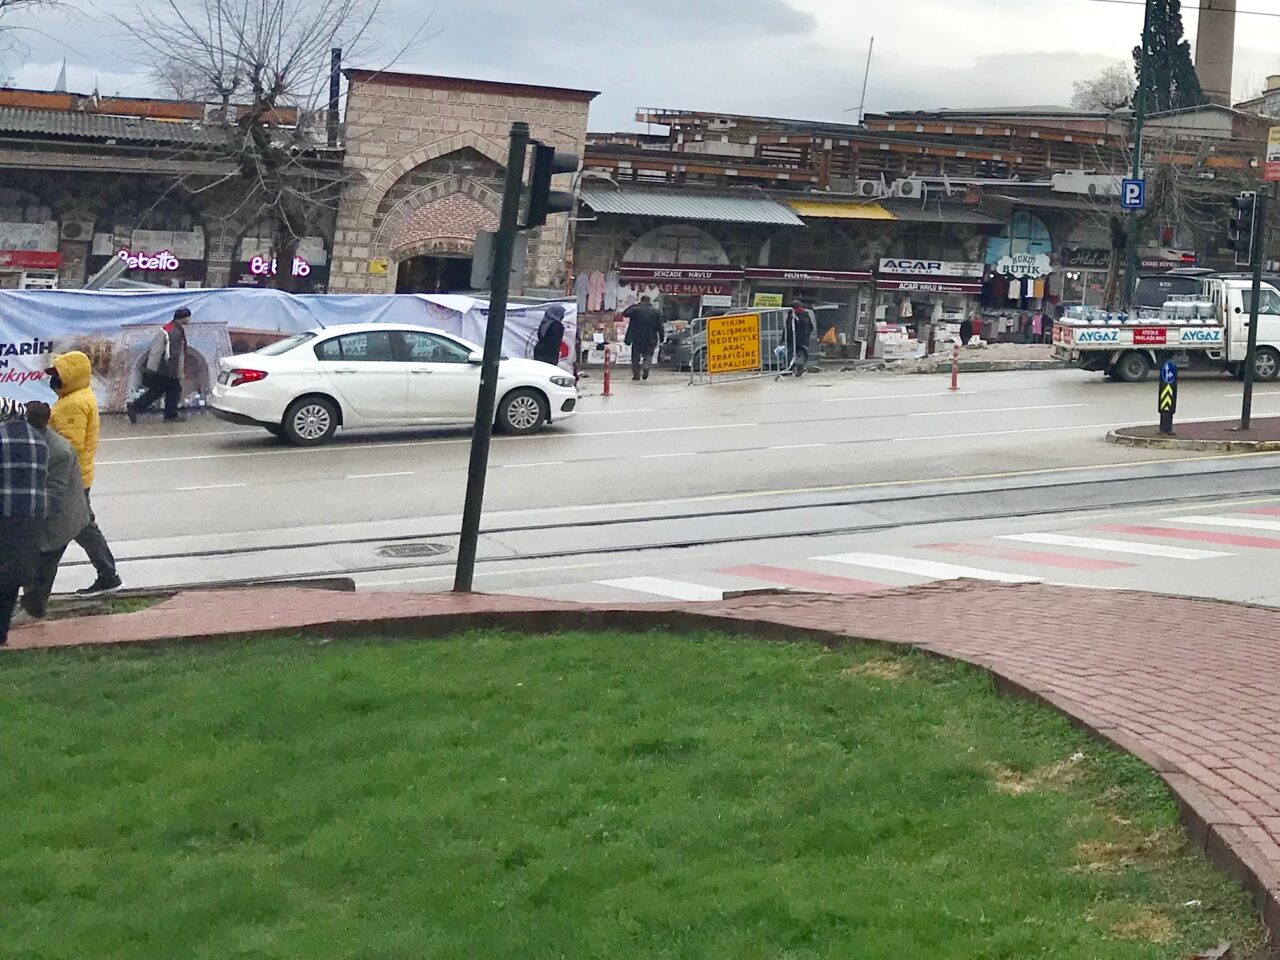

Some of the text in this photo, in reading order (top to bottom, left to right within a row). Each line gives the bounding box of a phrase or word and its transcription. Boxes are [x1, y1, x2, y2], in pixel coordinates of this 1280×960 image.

[1126, 184, 1140, 205] P
[251, 256, 311, 276] Bebtto
[883, 260, 941, 270] ACAR
[684, 284, 722, 294] HAVLU
[1079, 331, 1118, 341] AYGAZ
[1181, 331, 1220, 341] AYGAZ
